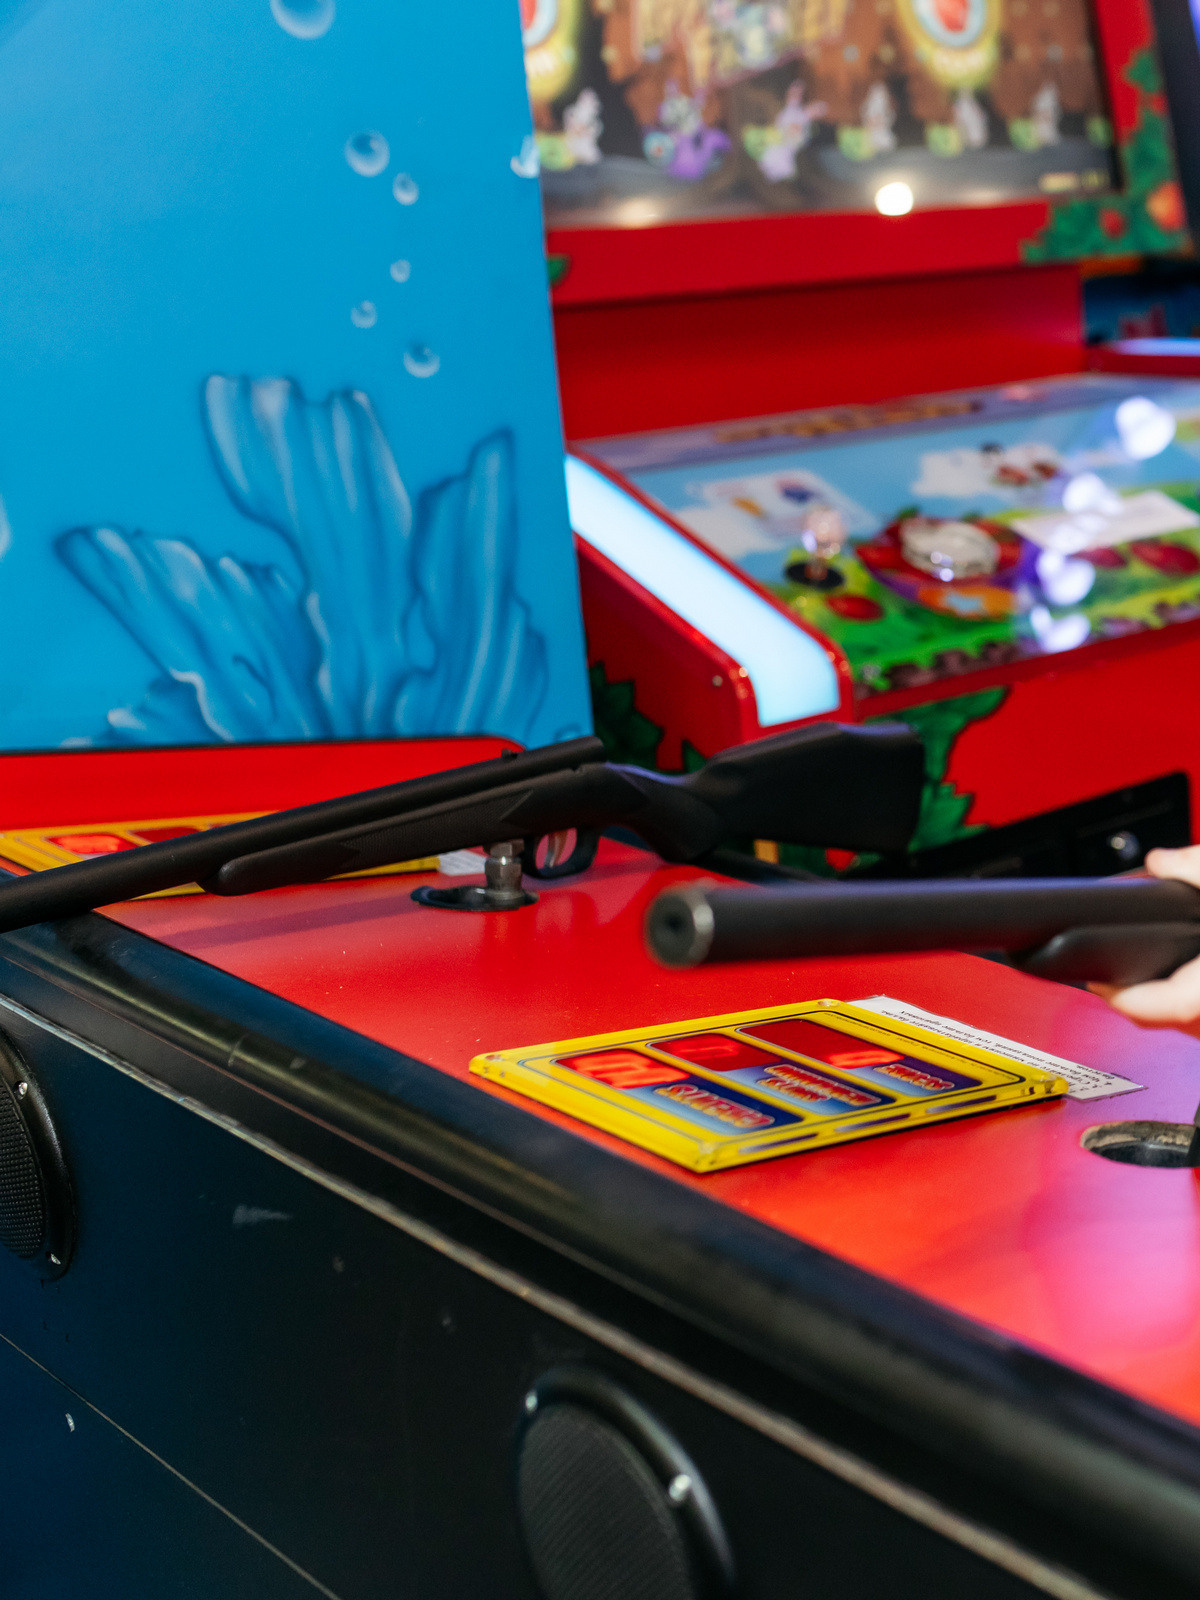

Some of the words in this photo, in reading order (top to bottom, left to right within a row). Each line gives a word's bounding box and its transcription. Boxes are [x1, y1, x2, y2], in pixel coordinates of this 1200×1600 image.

[756, 1077, 831, 1102] SHOTS
[873, 1063, 955, 1091] SCORE
[653, 1083, 775, 1128] CREDITS
